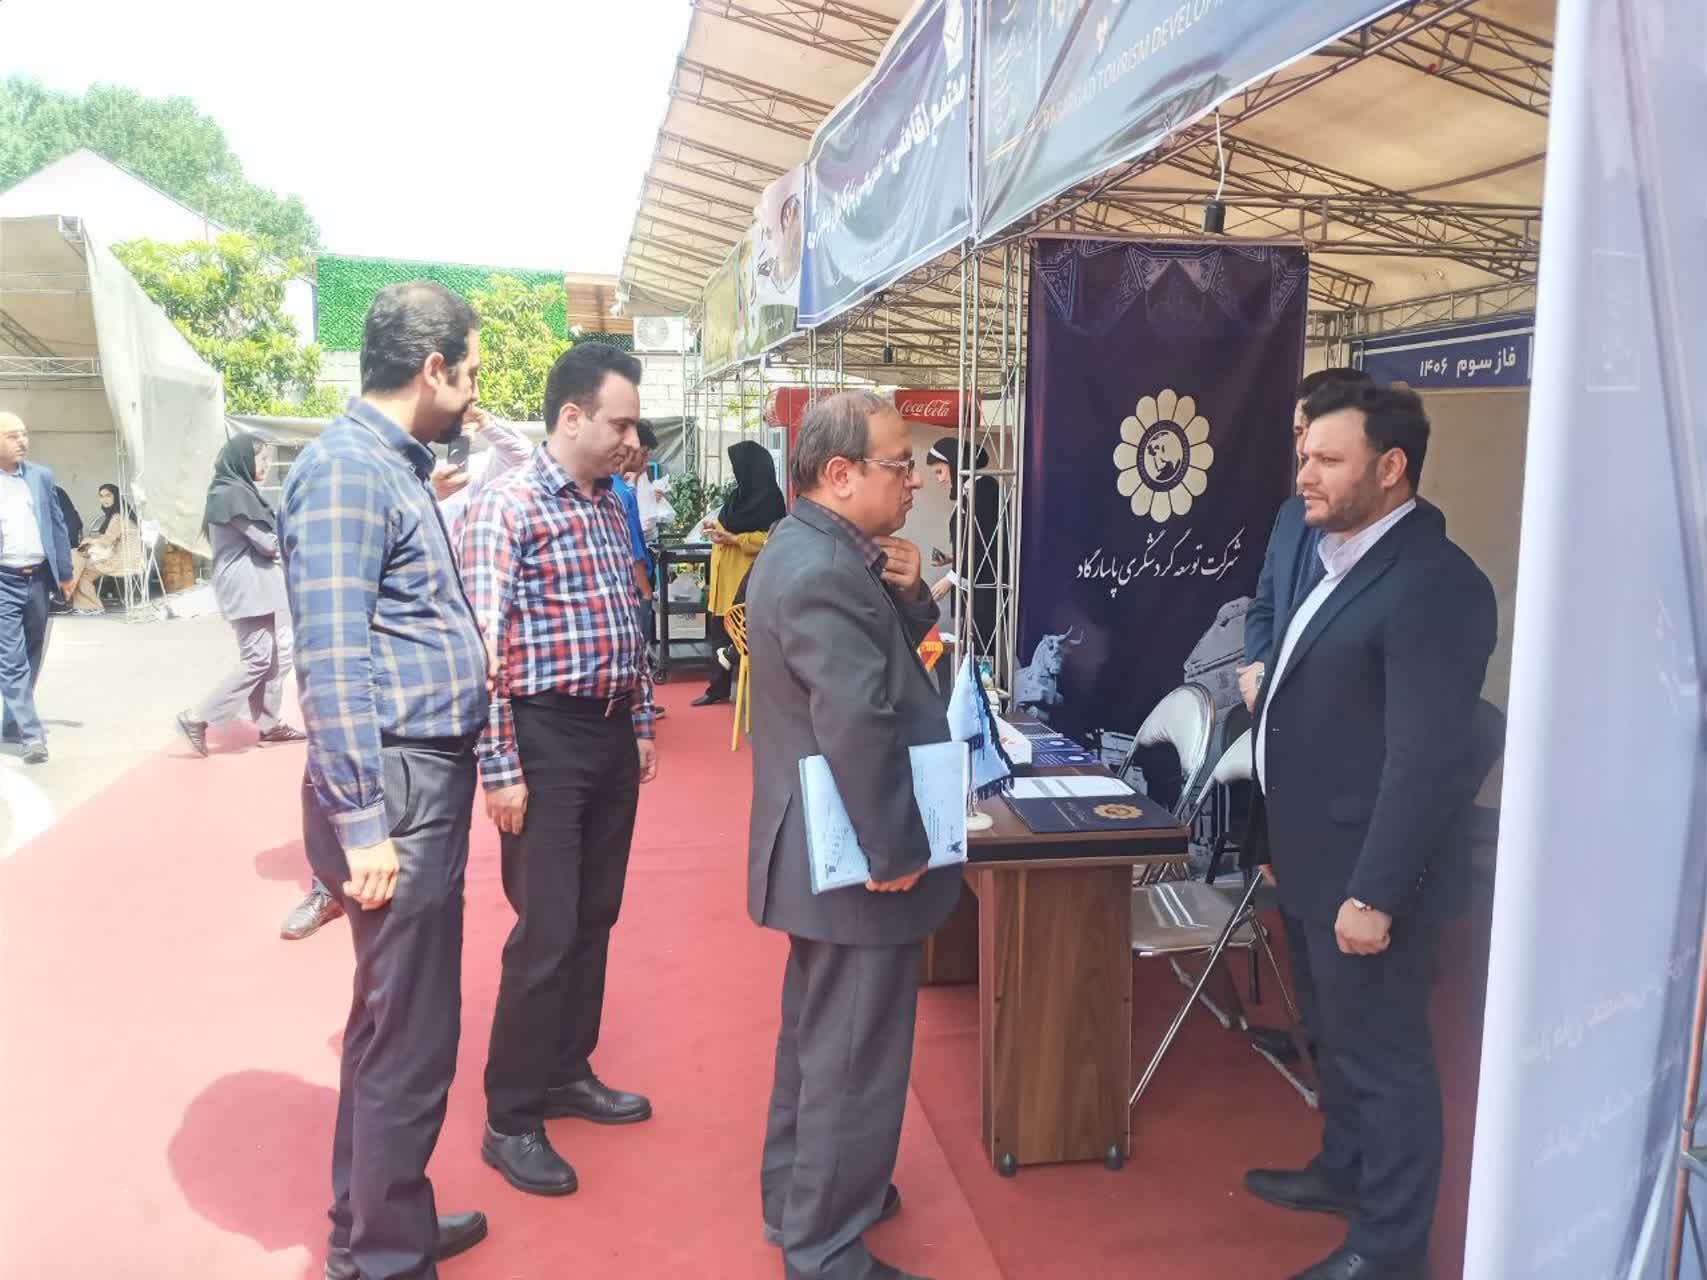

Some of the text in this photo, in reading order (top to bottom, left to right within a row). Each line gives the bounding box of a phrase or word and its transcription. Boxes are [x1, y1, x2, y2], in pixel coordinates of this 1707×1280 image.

[1419, 346, 1517, 379] فاز سوم ۱۴۰۶
[899, 399, 952, 417] Coca-Cola
[1076, 526, 1245, 598] شرکت توسعه گردشگری پاسارگاد
